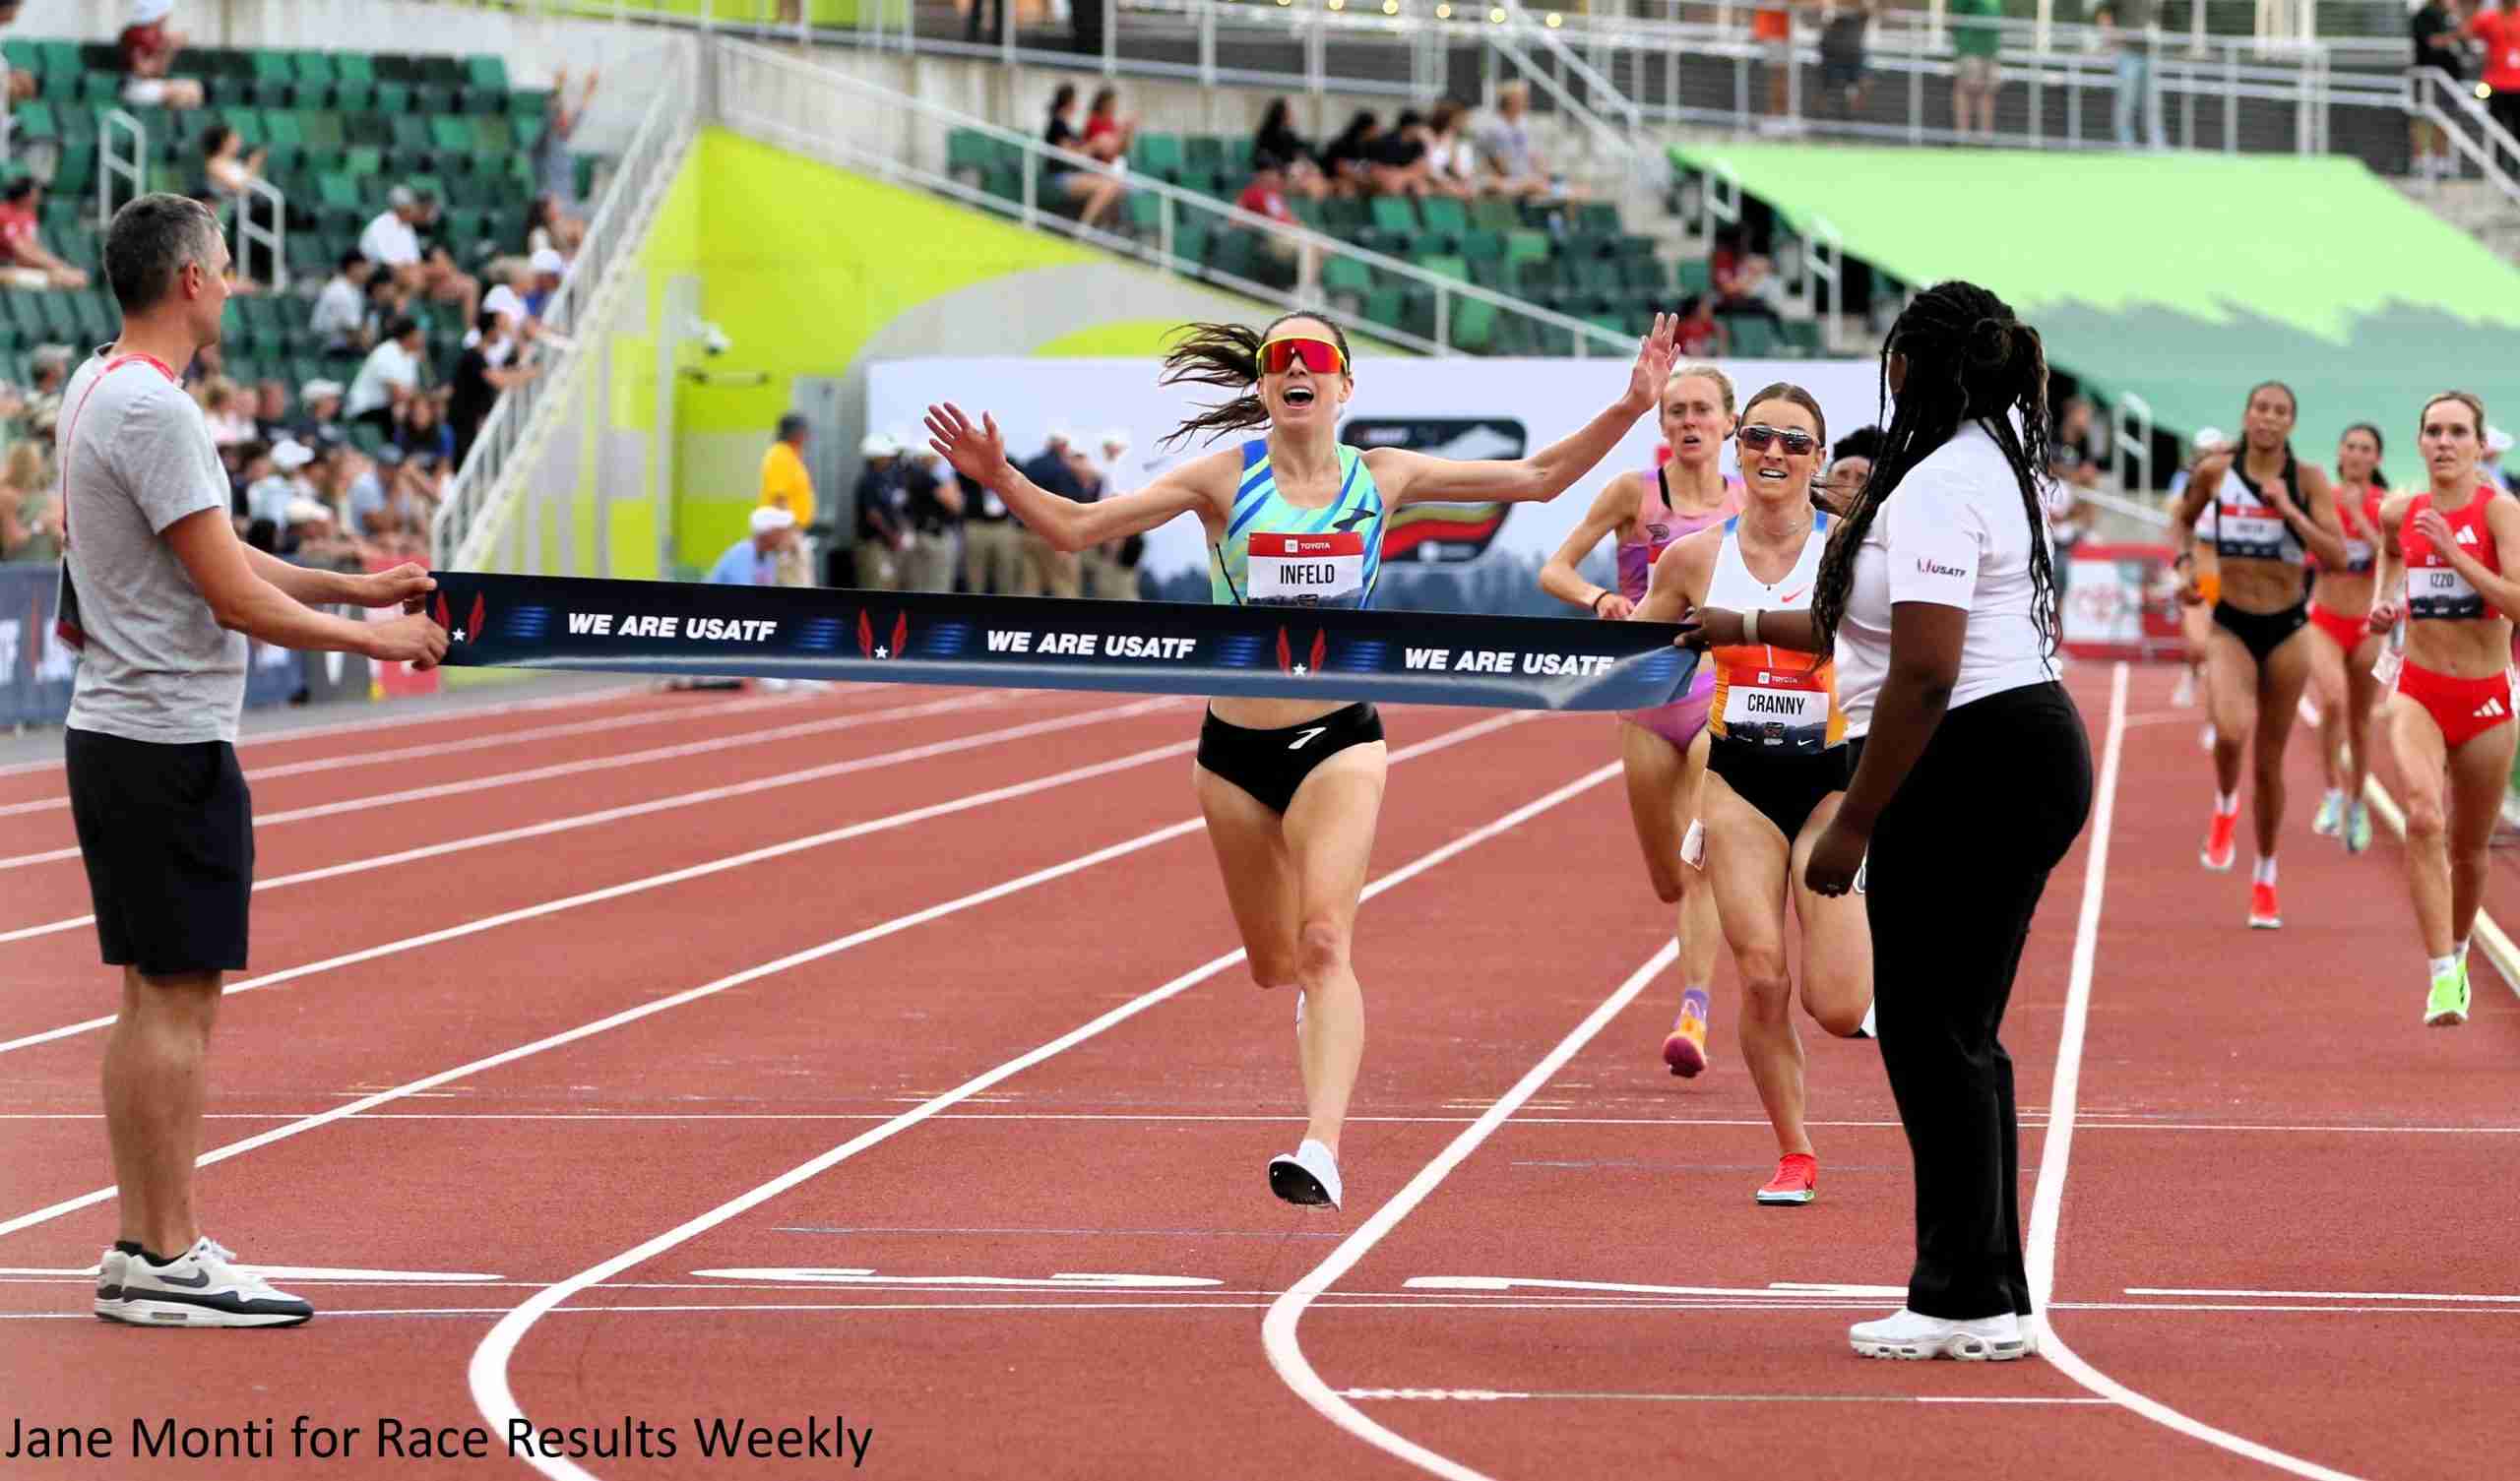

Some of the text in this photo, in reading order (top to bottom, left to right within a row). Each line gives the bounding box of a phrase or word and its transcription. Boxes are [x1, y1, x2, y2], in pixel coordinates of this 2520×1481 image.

[1281, 565, 1335, 584] INFELD
[2430, 573, 2454, 587] IZZO
[570, 613, 777, 641] WE ARE USATF
[988, 631, 1196, 658] WE ARE USATF
[1406, 648, 1613, 677] WE ARE USATF
[1748, 694, 1805, 714] CRANNY
